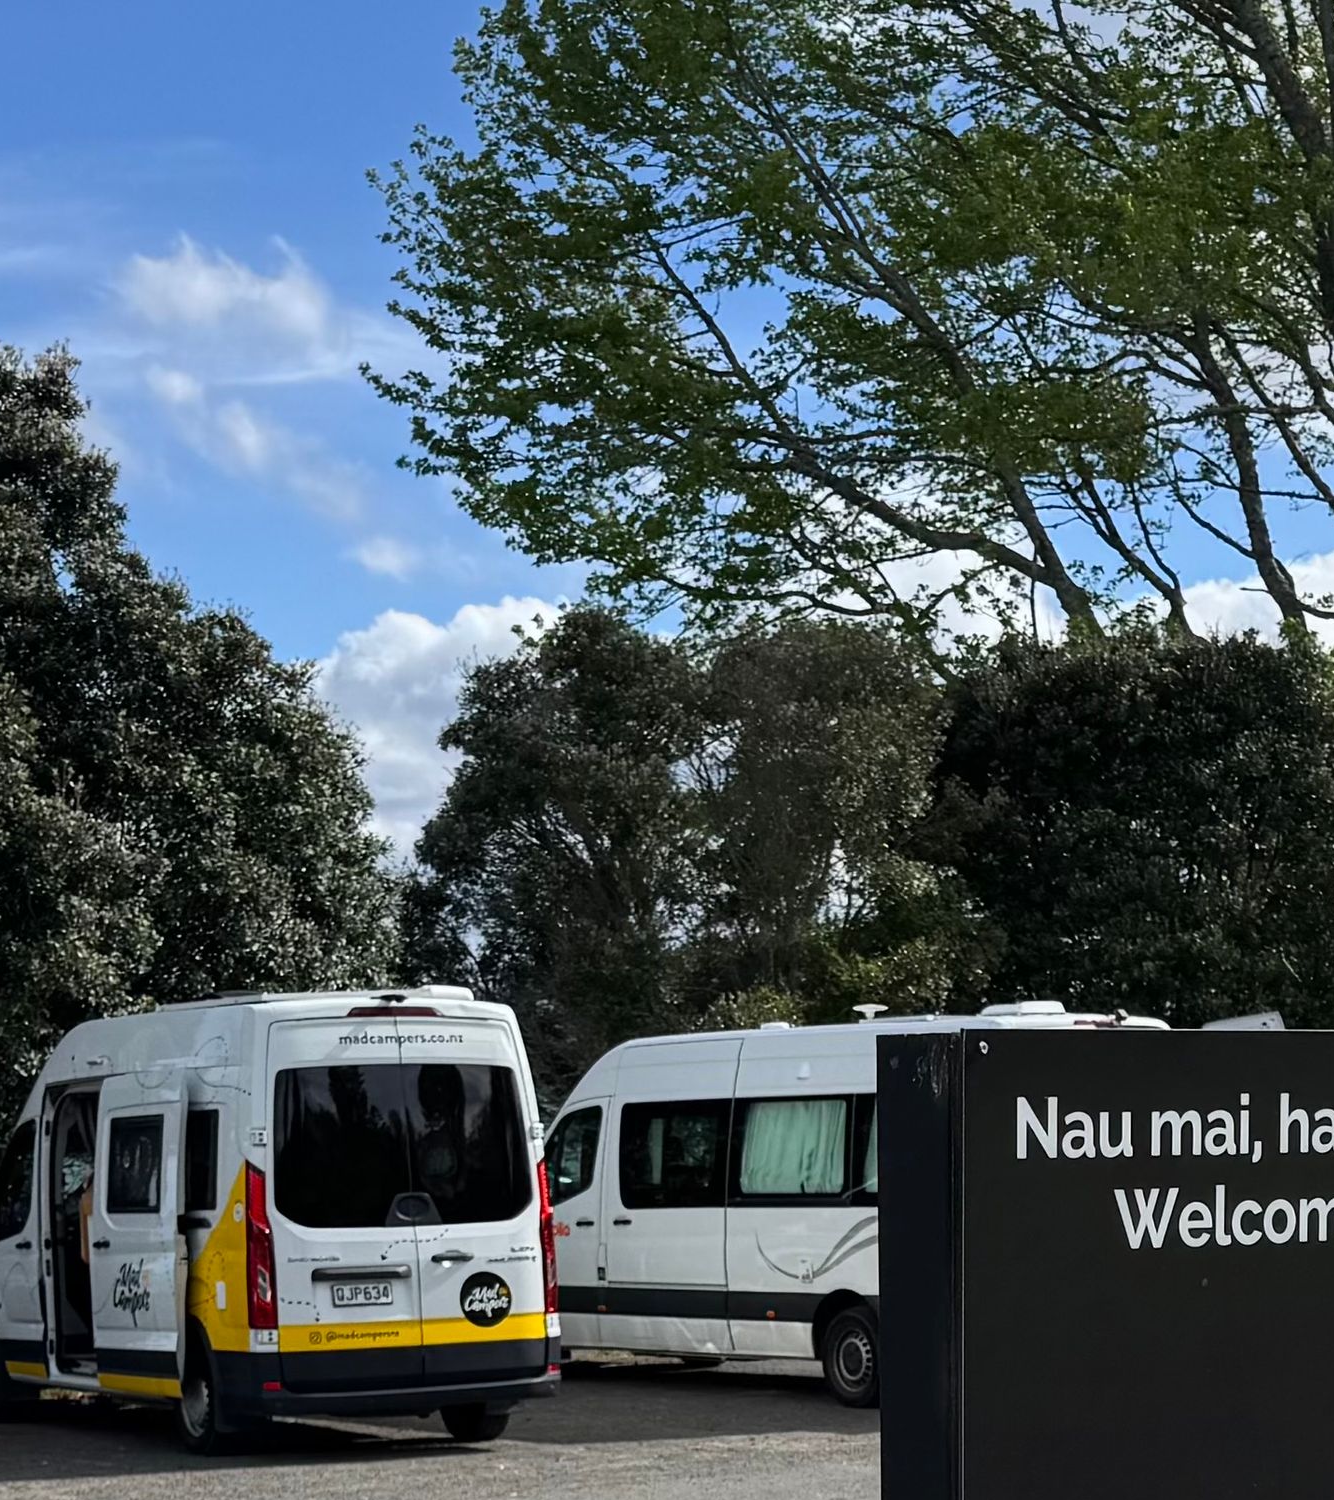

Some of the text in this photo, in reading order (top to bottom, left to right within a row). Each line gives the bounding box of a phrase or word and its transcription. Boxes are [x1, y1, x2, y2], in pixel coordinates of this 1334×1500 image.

[339, 1031, 464, 1049] madcampers.co.nz
[1017, 1097, 1133, 1159] Nau
[1151, 1093, 1261, 1163] mai,
